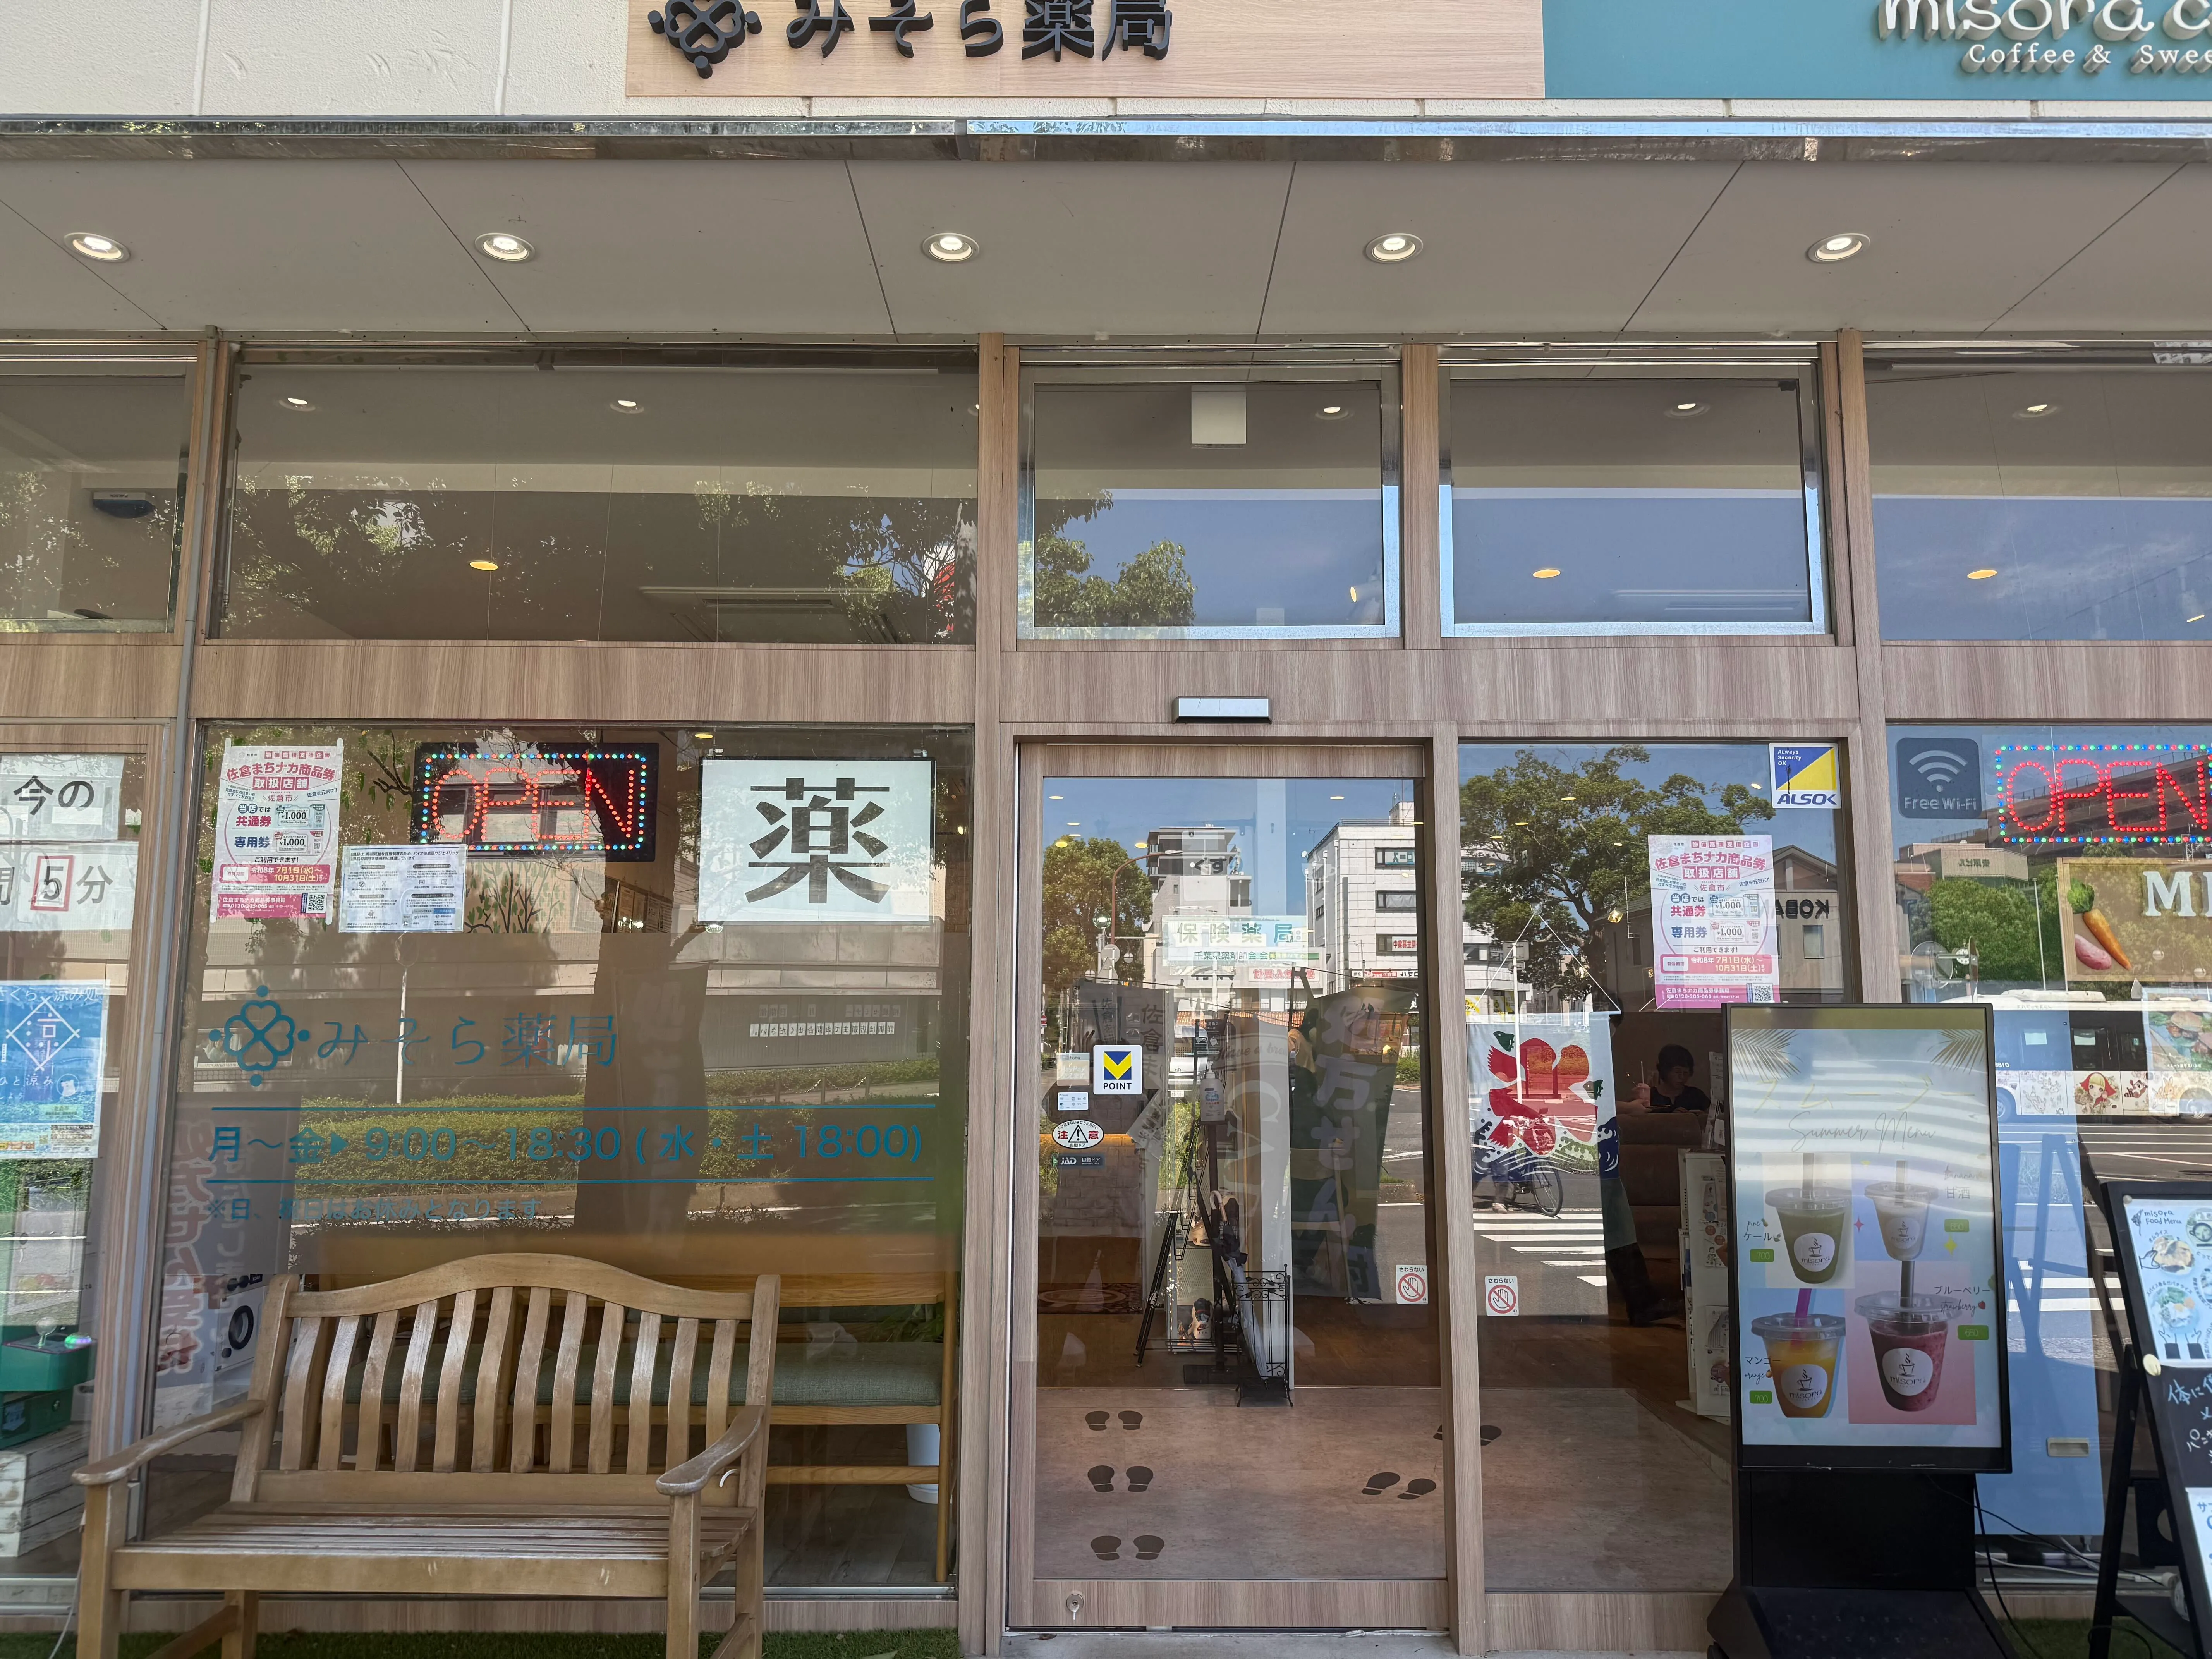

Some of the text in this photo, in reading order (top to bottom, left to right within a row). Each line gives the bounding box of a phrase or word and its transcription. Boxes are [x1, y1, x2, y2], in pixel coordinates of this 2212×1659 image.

[1967, 43, 2075, 66] Coffee
[2090, 43, 2111, 66] &
[227, 761, 336, 781] 佐倉まちナカ商品券
[253, 777, 310, 790] 取扱店舗
[14, 775, 94, 815] 今の
[1777, 794, 1837, 805] ALSOK
[2007, 759, 2209, 831] OPEN
[238, 803, 271, 814] 当店では
[432, 767, 635, 839] OPEN
[1905, 797, 1977, 811] Free Wi-Fi
[236, 816, 271, 827] 共通券
[234, 836, 270, 848] 専用券
[744, 778, 891, 904] 薬
[1655, 851, 1767, 871] 佐倉まちナカ商品券
[1683, 866, 1740, 879] 取扱店舗
[1670, 893, 1704, 904] 当店では
[1670, 905, 1706, 917] 共通券
[1177, 923, 1293, 943] 保険薬局
[1671, 926, 1707, 938] 専用券
[317, 1012, 618, 1069] みそら薬局
[1788, 1111, 1936, 1154] Summer Menu
[1743, 1232, 1772, 1241] ケール
[1757, 1252, 1770, 1260] 700
[1934, 1286, 1991, 1295] ブルーベリー
[1754, 1395, 1768, 1403] 700
[1790, 1389, 1823, 1399] misora
